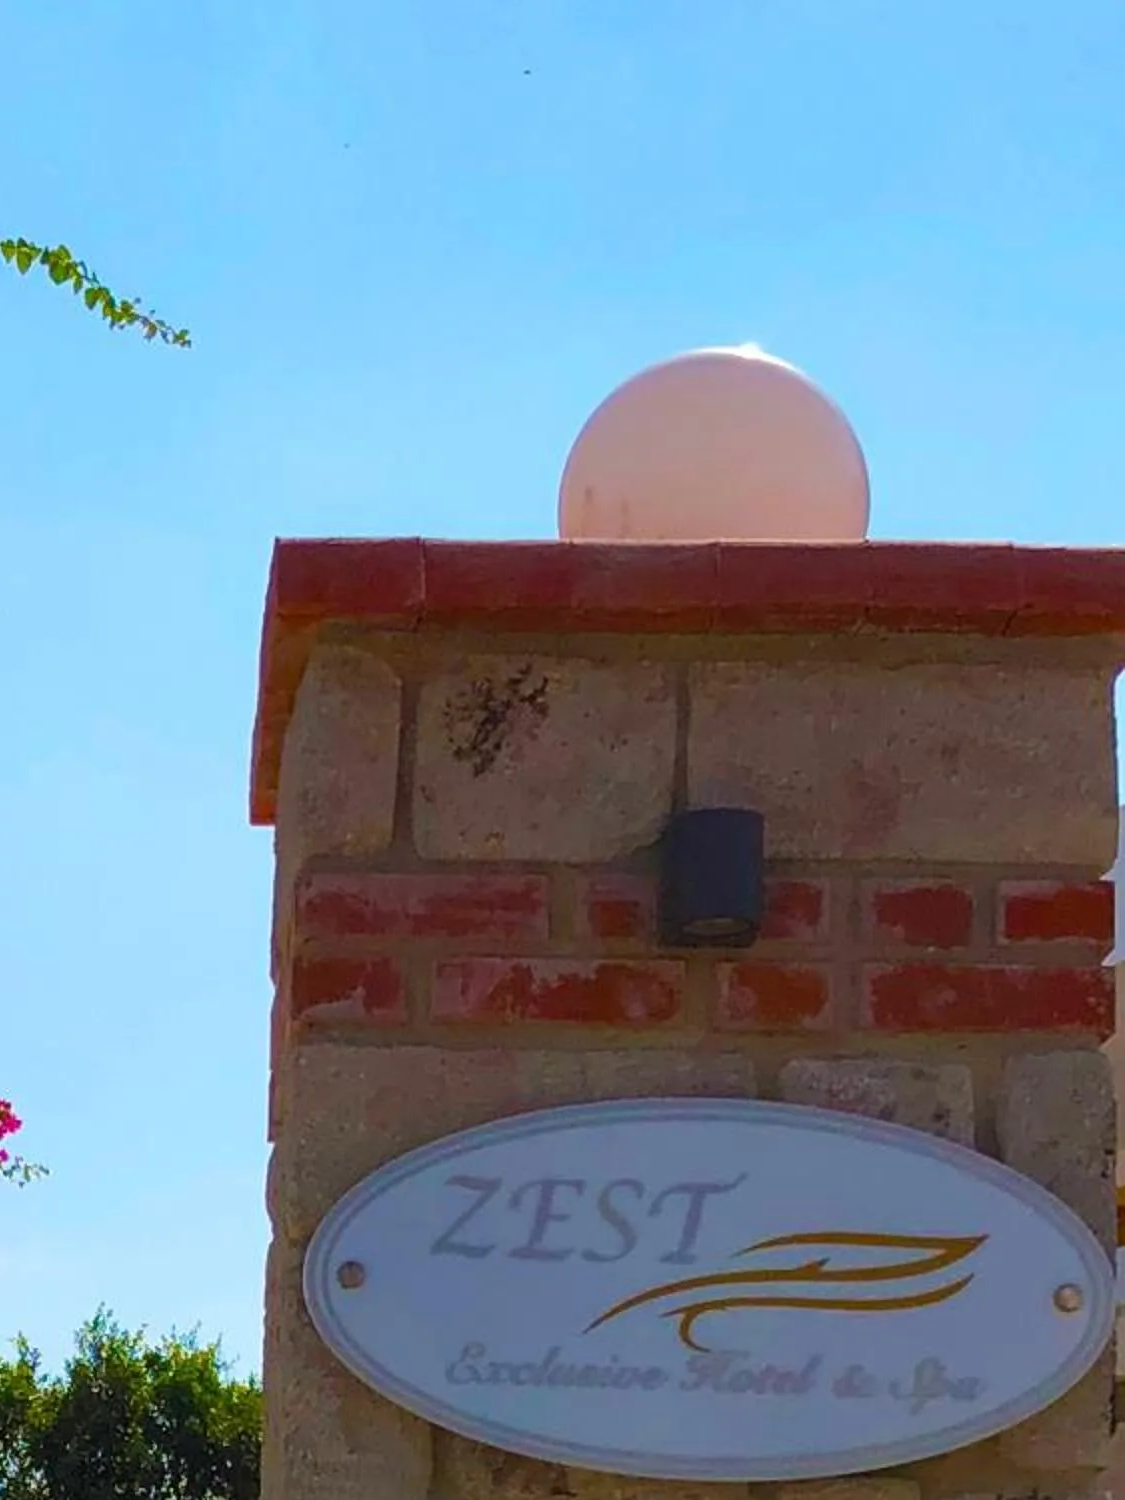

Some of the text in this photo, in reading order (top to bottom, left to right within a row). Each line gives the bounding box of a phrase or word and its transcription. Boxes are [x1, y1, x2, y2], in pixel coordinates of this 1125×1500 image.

[430, 1171, 750, 1265] ZEST
[445, 1340, 987, 1416] Exclusive Hotel & Spa
